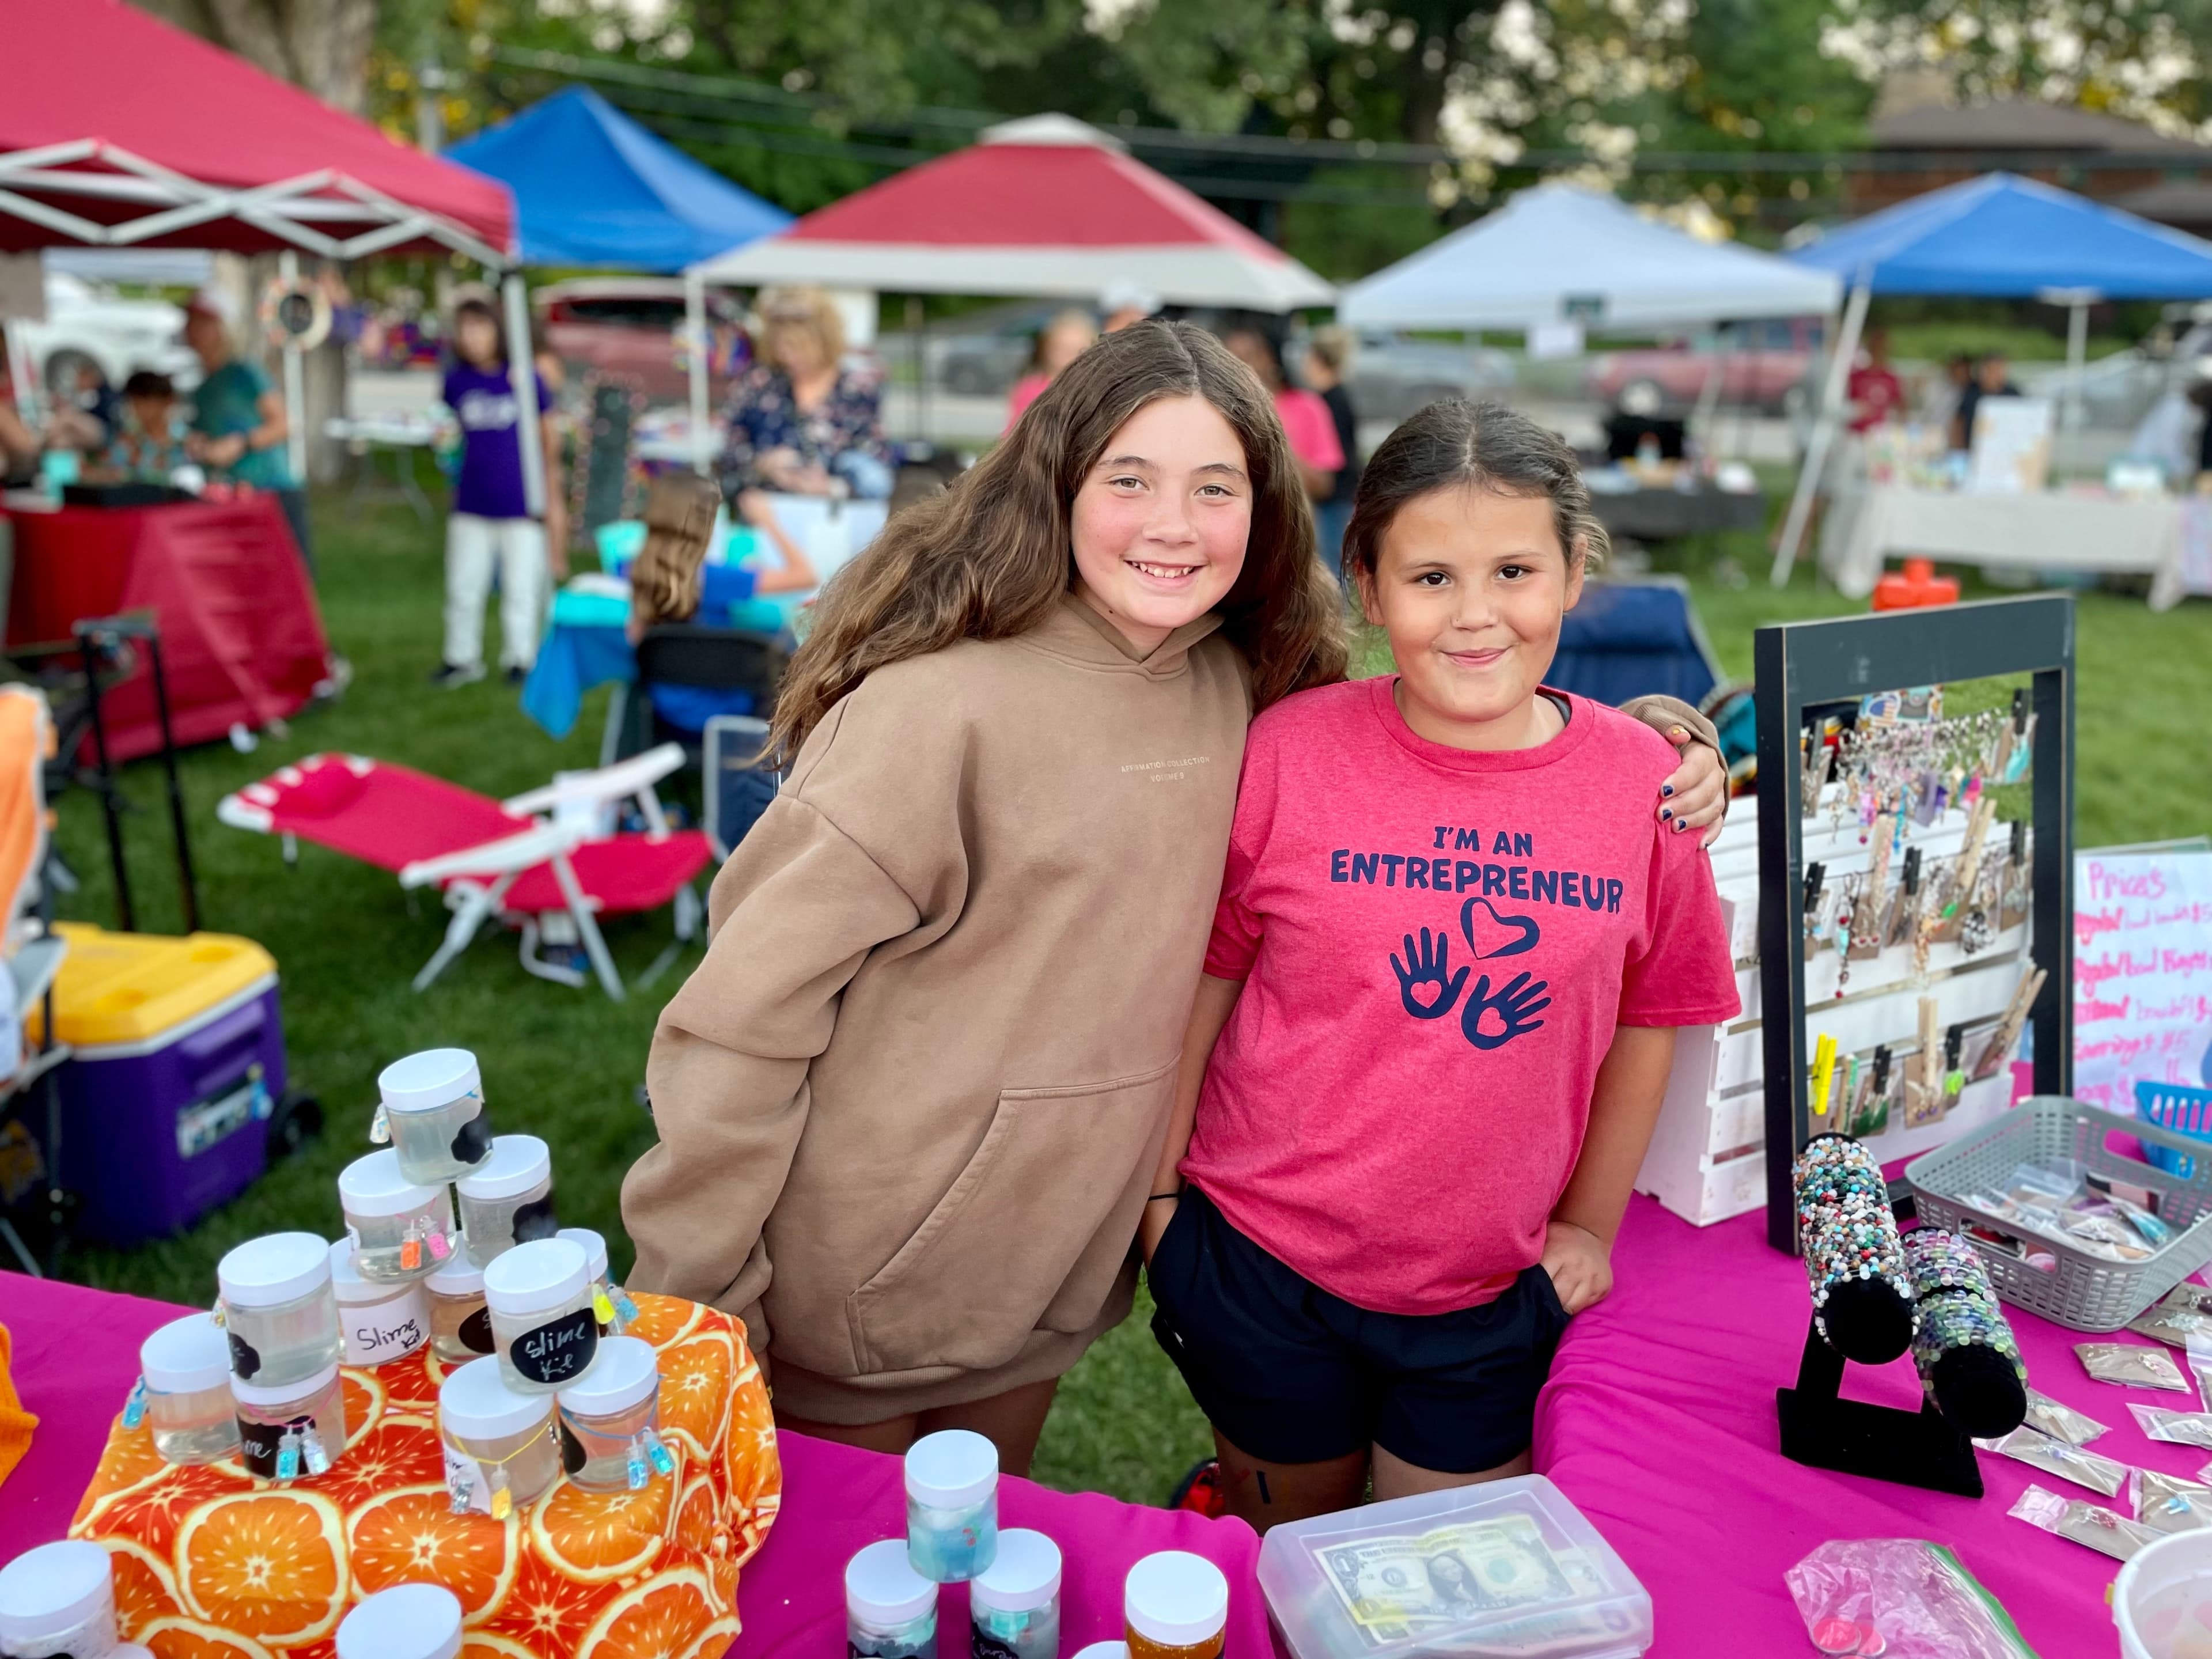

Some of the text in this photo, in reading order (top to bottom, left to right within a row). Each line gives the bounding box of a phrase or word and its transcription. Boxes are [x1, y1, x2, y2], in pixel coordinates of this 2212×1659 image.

[1167, 756, 1210, 768] COLLECTION
[1433, 826, 1532, 857] I'M AN
[1331, 849, 1623, 914] ENTREPRENEUR
[357, 1319, 416, 1350] Slime
[525, 1322, 585, 1359] Slime
